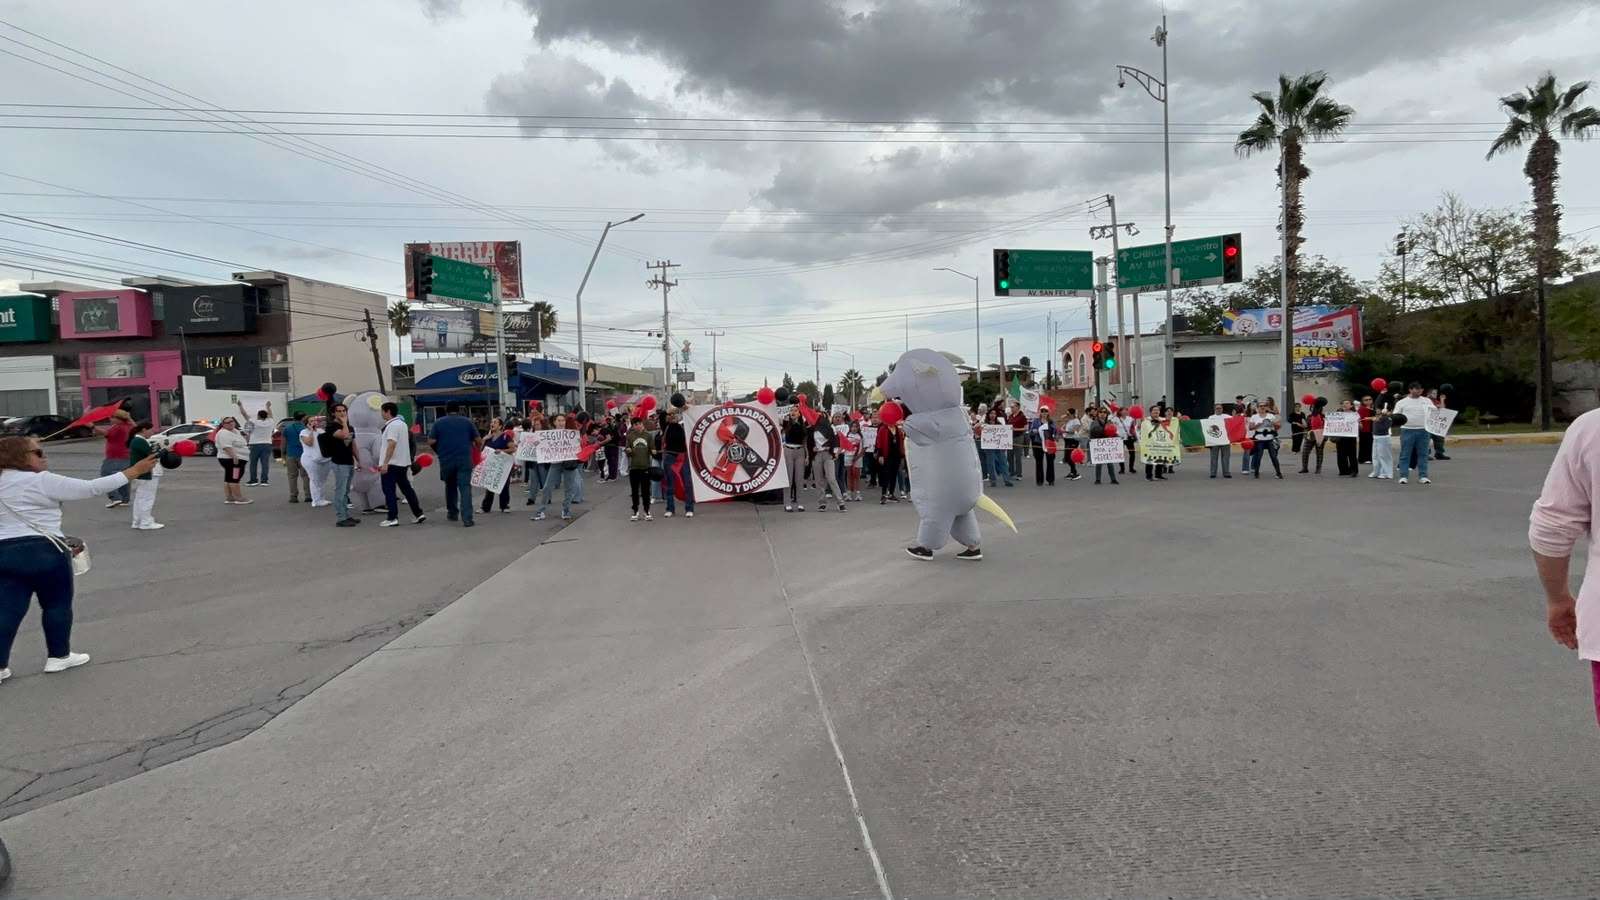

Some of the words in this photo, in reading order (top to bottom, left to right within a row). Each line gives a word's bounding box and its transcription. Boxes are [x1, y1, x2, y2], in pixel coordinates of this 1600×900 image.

[1132, 245, 1186, 260] CHIHUAUA
[1147, 254, 1201, 269] MIRDOR
[693, 420, 710, 444] BASE
[708, 407, 774, 433] TRABAJADORA
[540, 430, 576, 441] SEGURO
[700, 468, 733, 493] UNIDAD
[734, 484, 742, 493] Y
[742, 458, 777, 492] DIGNIDAD
